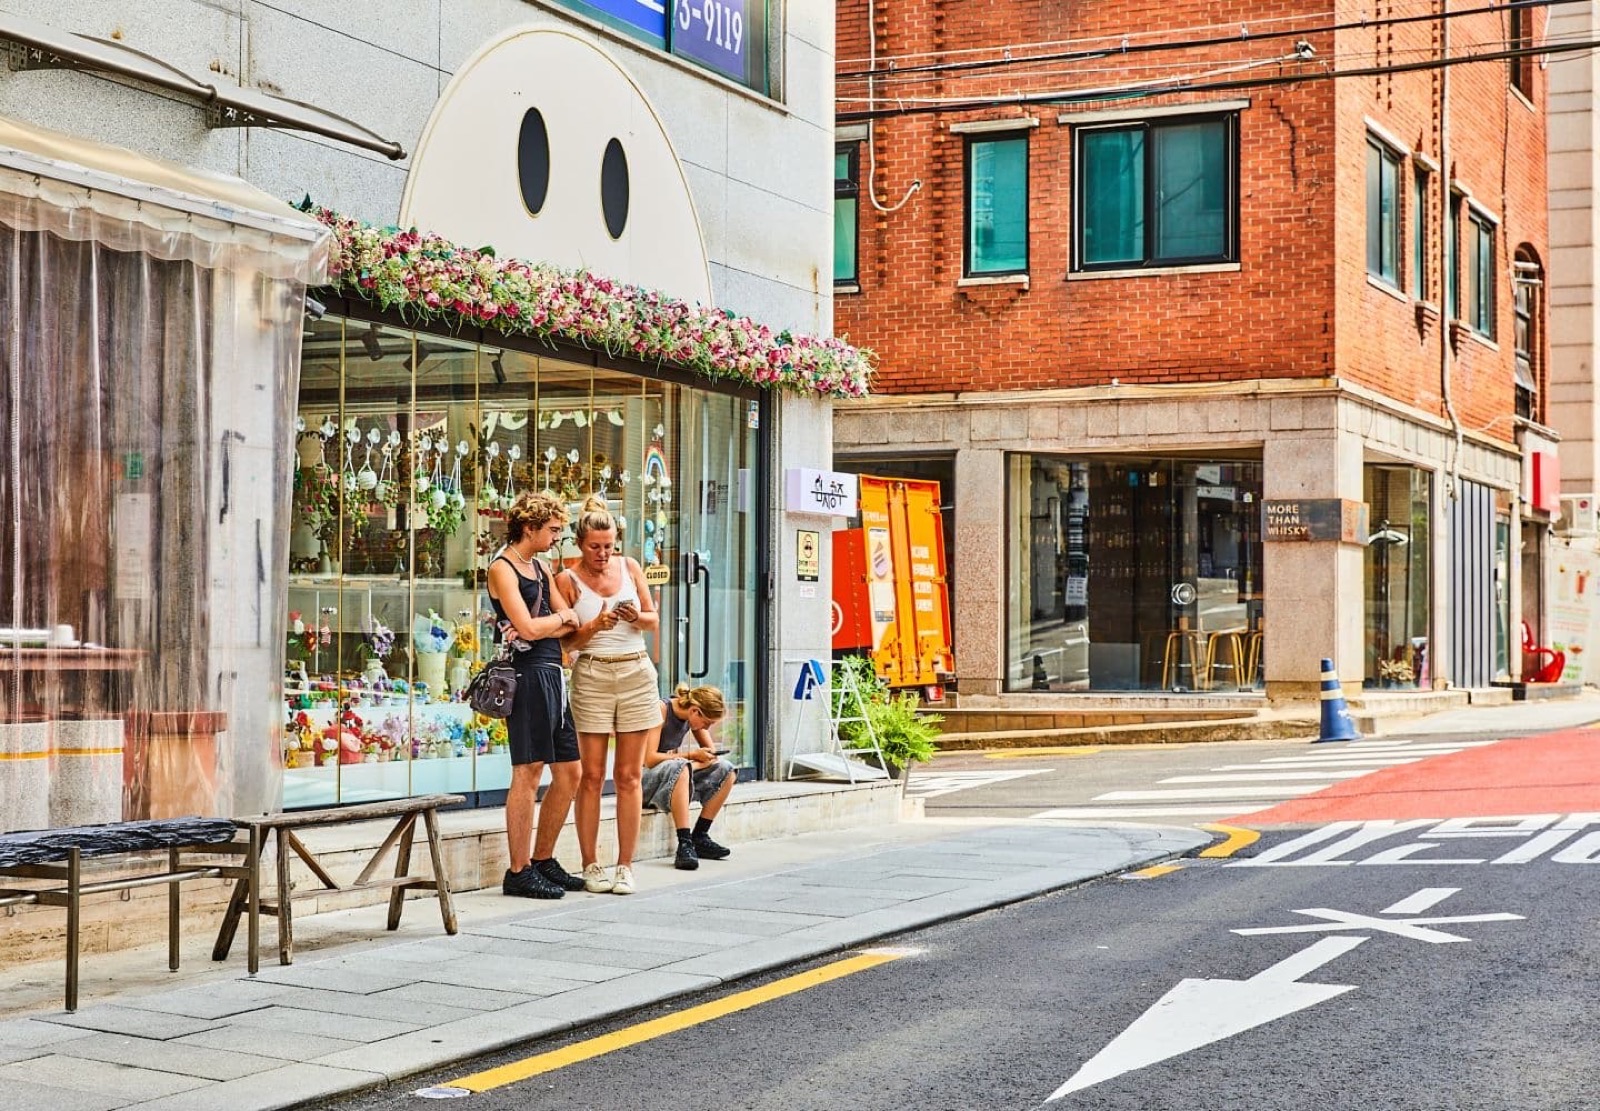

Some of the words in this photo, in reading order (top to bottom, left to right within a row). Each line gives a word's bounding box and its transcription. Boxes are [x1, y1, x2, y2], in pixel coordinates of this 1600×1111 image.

[674, 0, 743, 54] 3-9119
[1267, 505, 1299, 514] MORE
[1269, 516, 1299, 525] THAN
[1268, 527, 1307, 535] WHISKY
[646, 571, 668, 579] CLOSED
